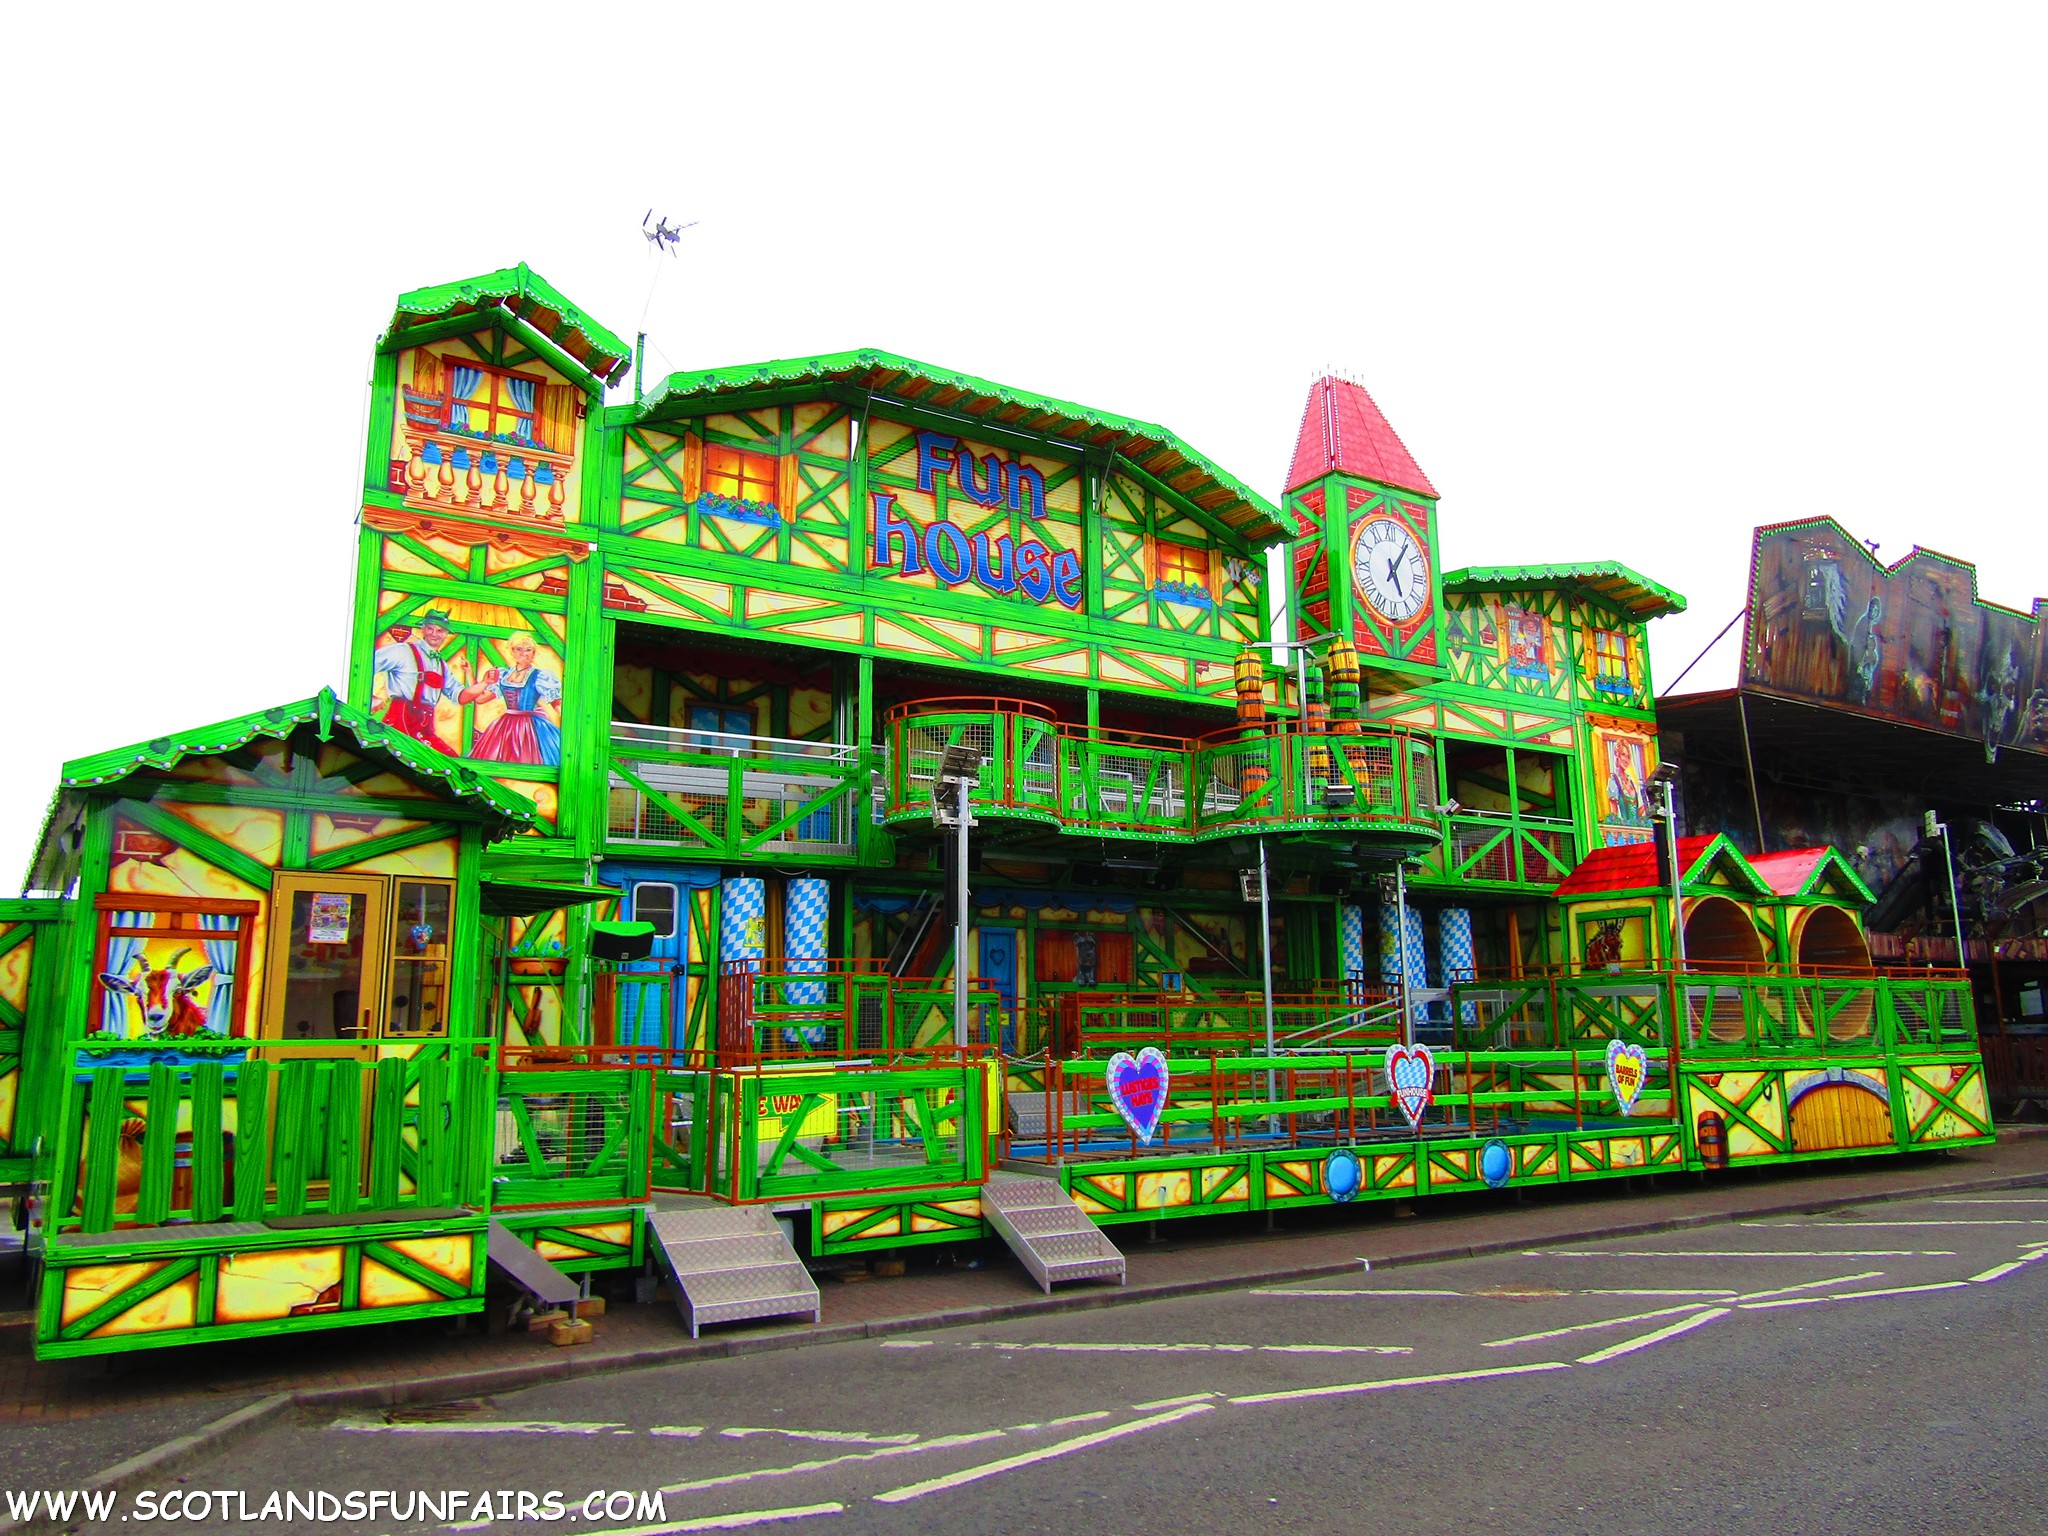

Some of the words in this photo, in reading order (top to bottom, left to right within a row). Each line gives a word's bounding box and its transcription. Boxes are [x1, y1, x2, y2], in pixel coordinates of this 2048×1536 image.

[916, 431, 1048, 520] Fun
[1369, 526, 1382, 544] XI
[1384, 524, 1396, 542] XII
[872, 493, 1084, 610] house
[1360, 539, 1373, 554] X
[1358, 560, 1370, 572] IX
[1409, 555, 1420, 565] II
[1413, 573, 1424, 585] III
[1615, 1064, 1638, 1078] BARRELS
[1618, 1074, 1625, 1084] OF
[1625, 1076, 1636, 1087] FUN
[772, 1094, 803, 1114] WA
